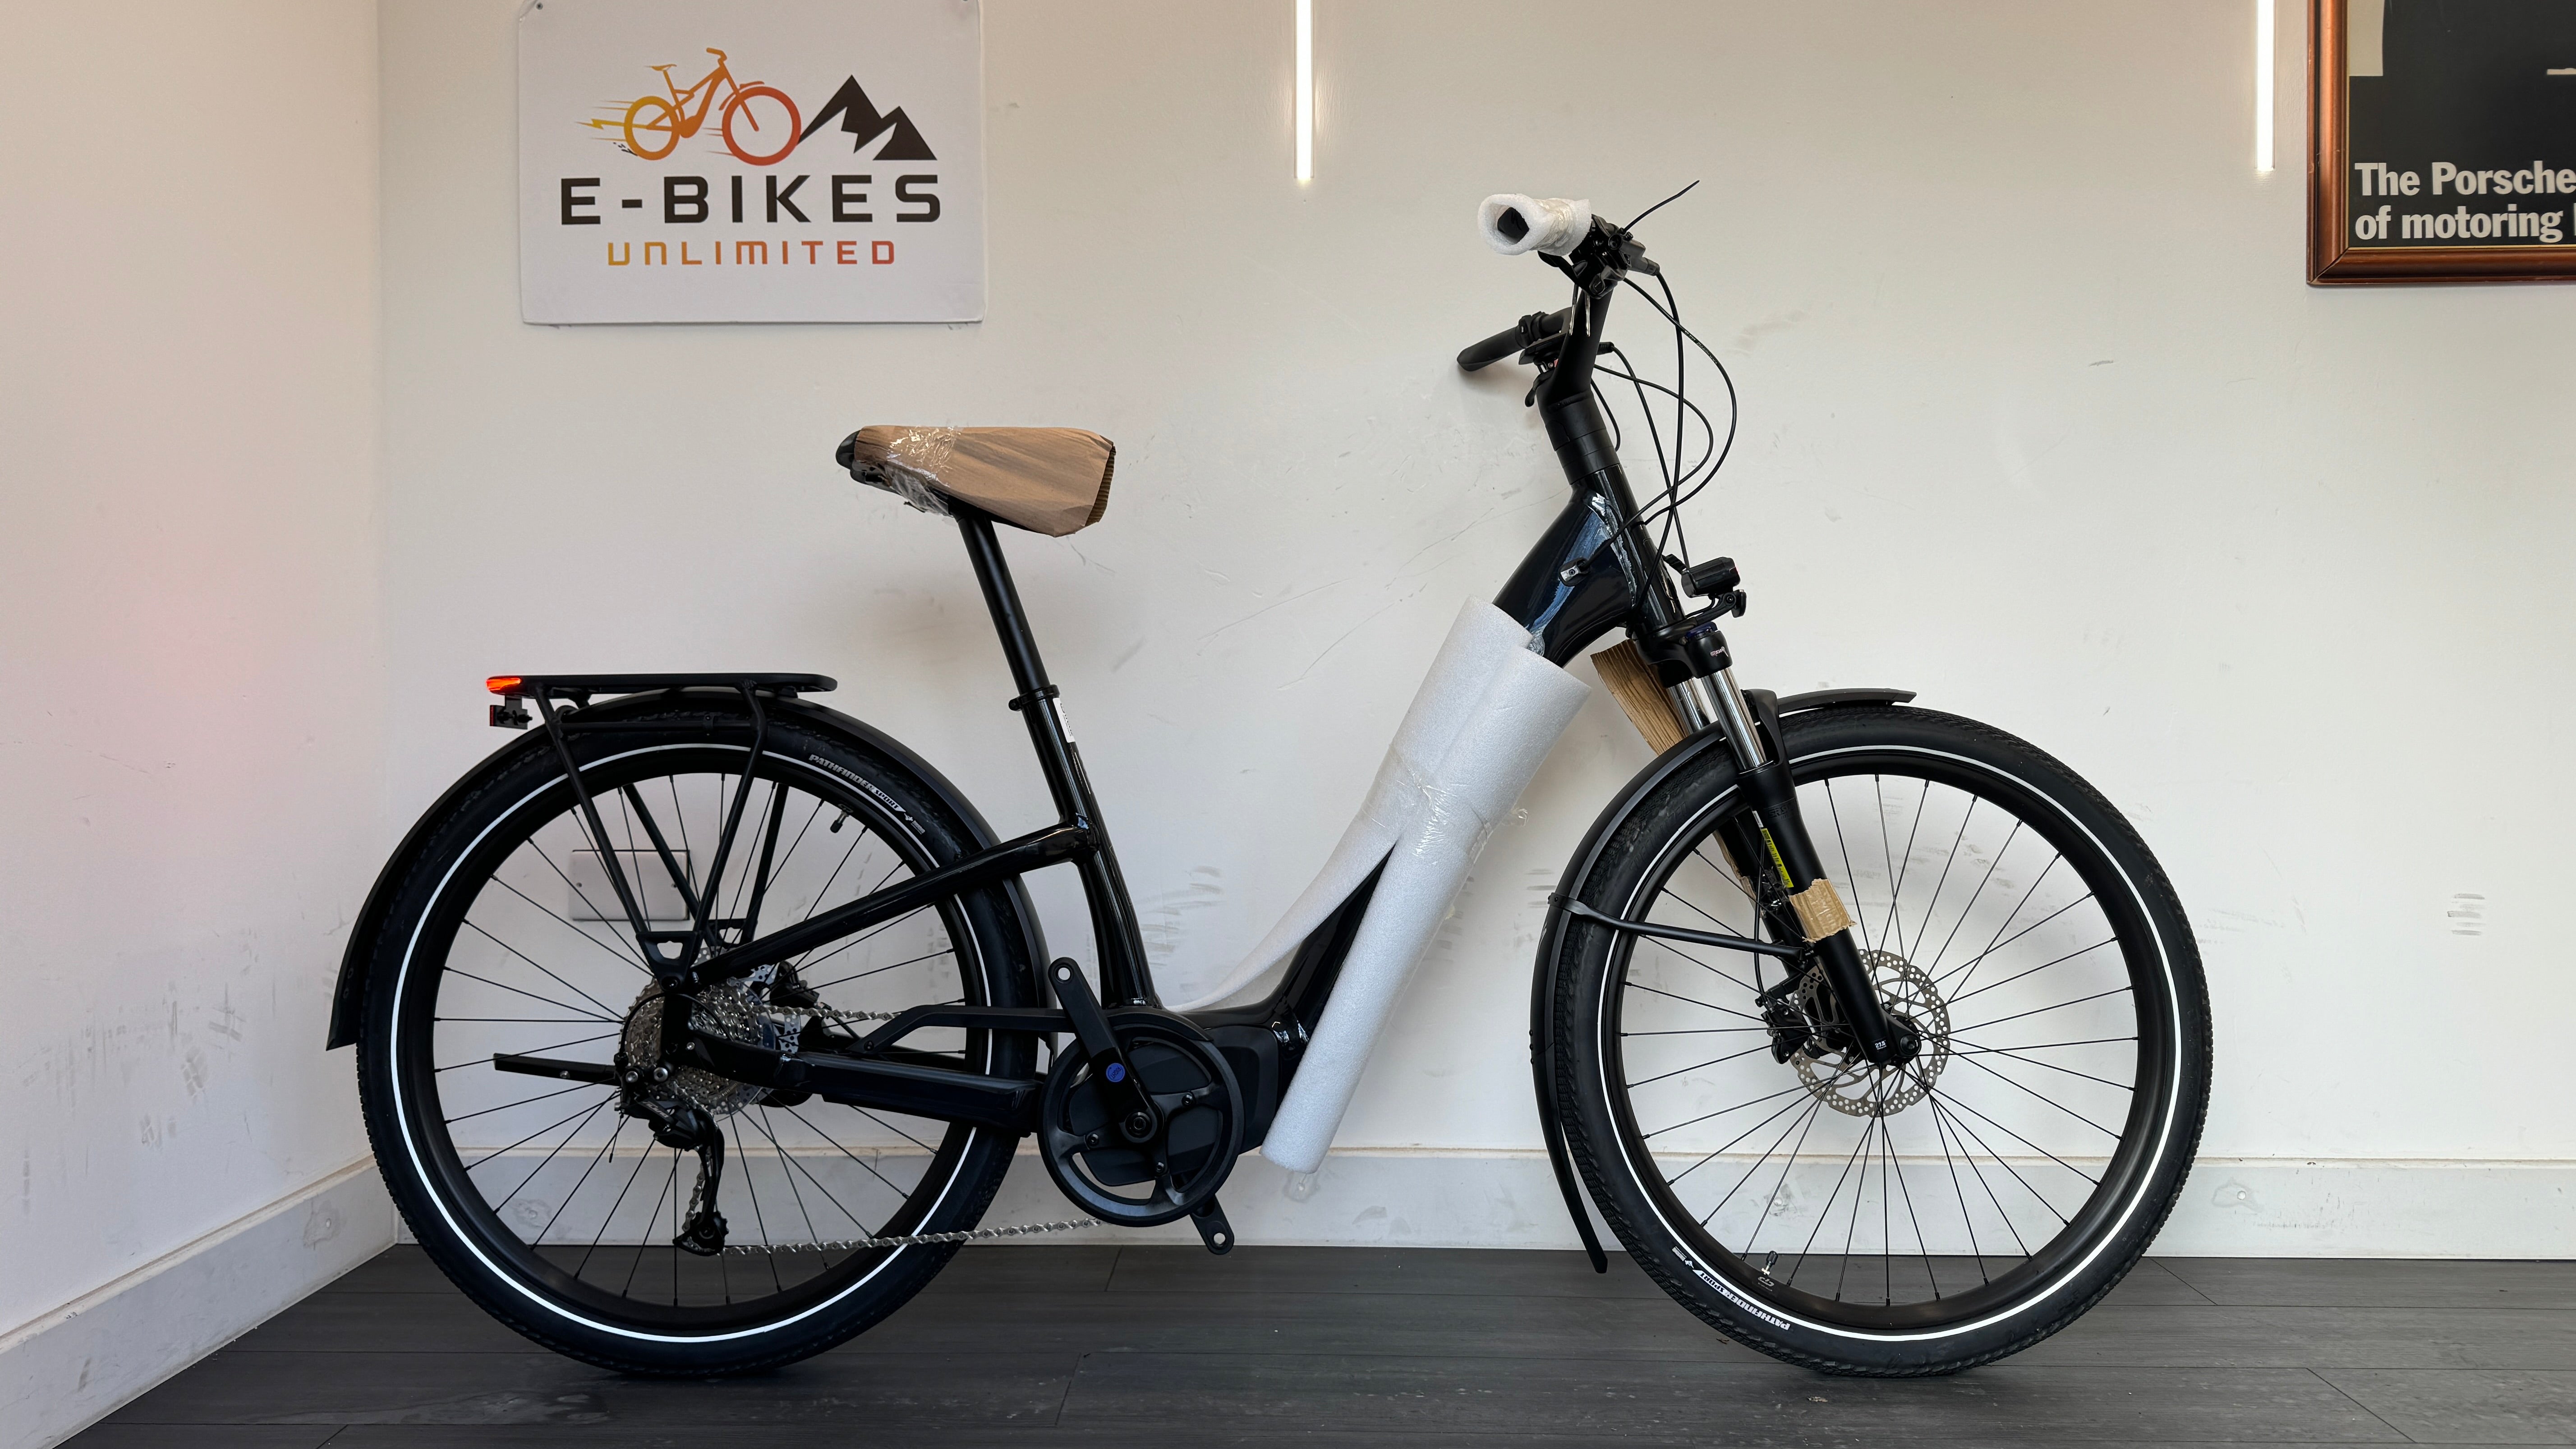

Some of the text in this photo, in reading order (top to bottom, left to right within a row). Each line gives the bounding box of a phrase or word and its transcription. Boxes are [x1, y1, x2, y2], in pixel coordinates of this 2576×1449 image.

[2355, 160, 2576, 196] The Porsche
[561, 175, 941, 225] E-BIKES
[2355, 205, 2391, 240] of
[2402, 203, 2563, 243] motoring
[607, 240, 895, 266] UNLIMITED
[809, 754, 899, 810] PATHFINDER SPORT
[1699, 1272, 1726, 1293] SPORT
[1726, 1292, 1790, 1331] PATHFINDER
